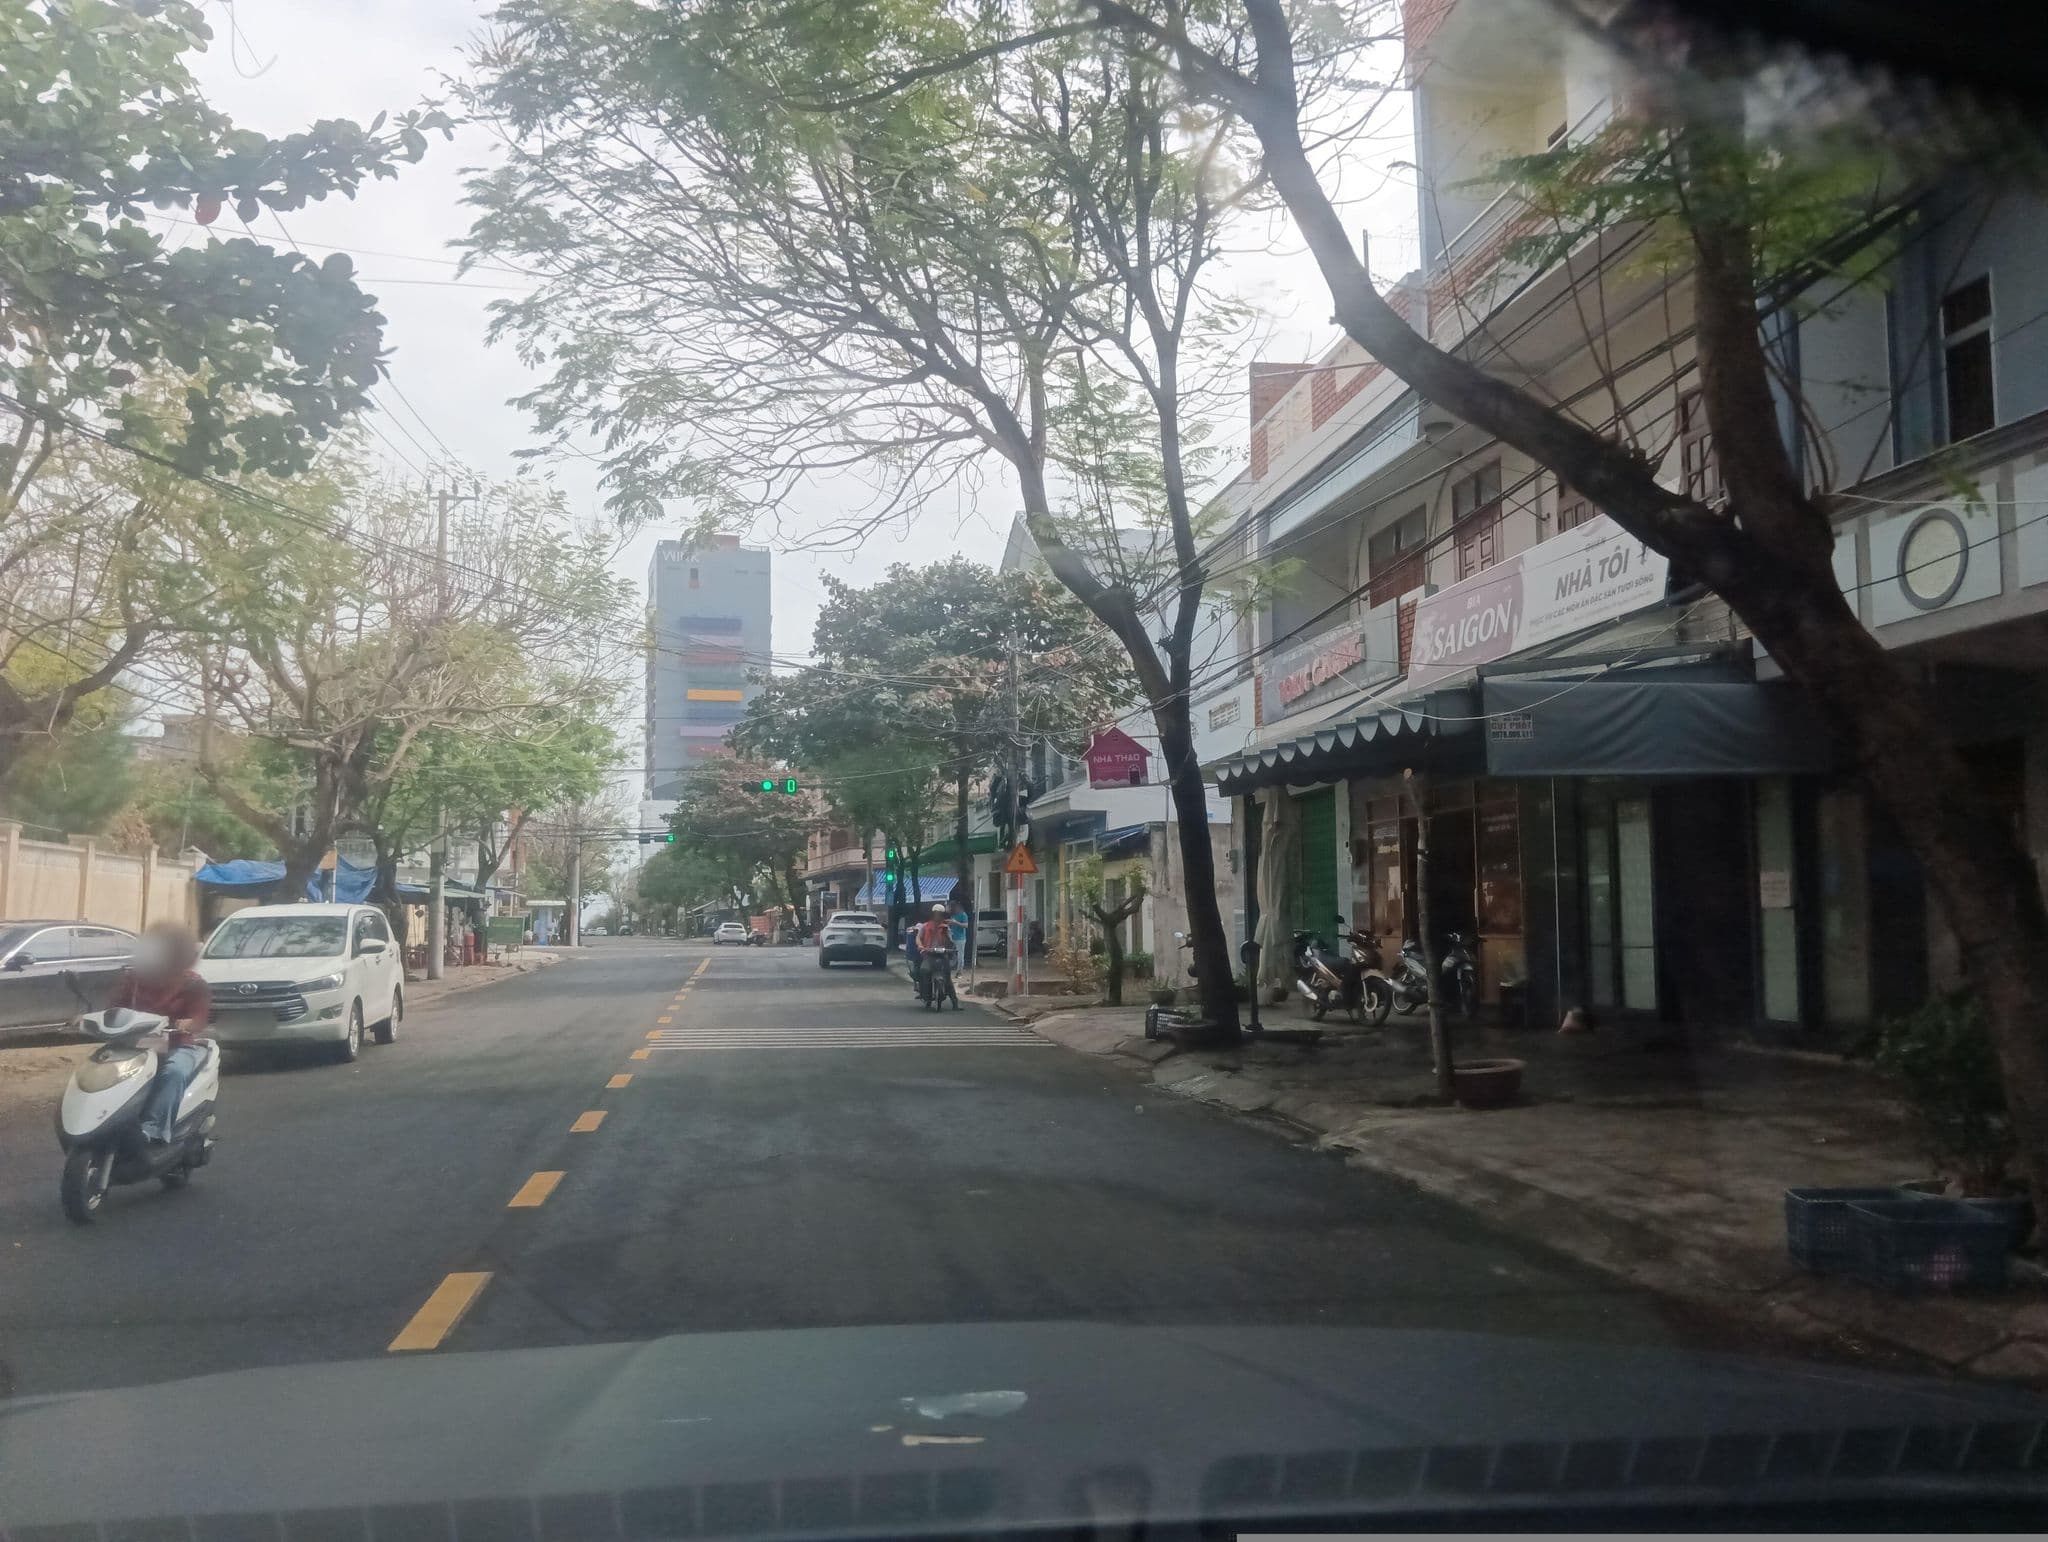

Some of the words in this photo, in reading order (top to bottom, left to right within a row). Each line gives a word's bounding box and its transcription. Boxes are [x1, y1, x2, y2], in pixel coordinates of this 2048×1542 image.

[1556, 558, 1592, 601] NHÀ
[1599, 545, 1630, 583] TÔI
[1432, 597, 1513, 661] SAIGON
[787, 779, 796, 793] 0
